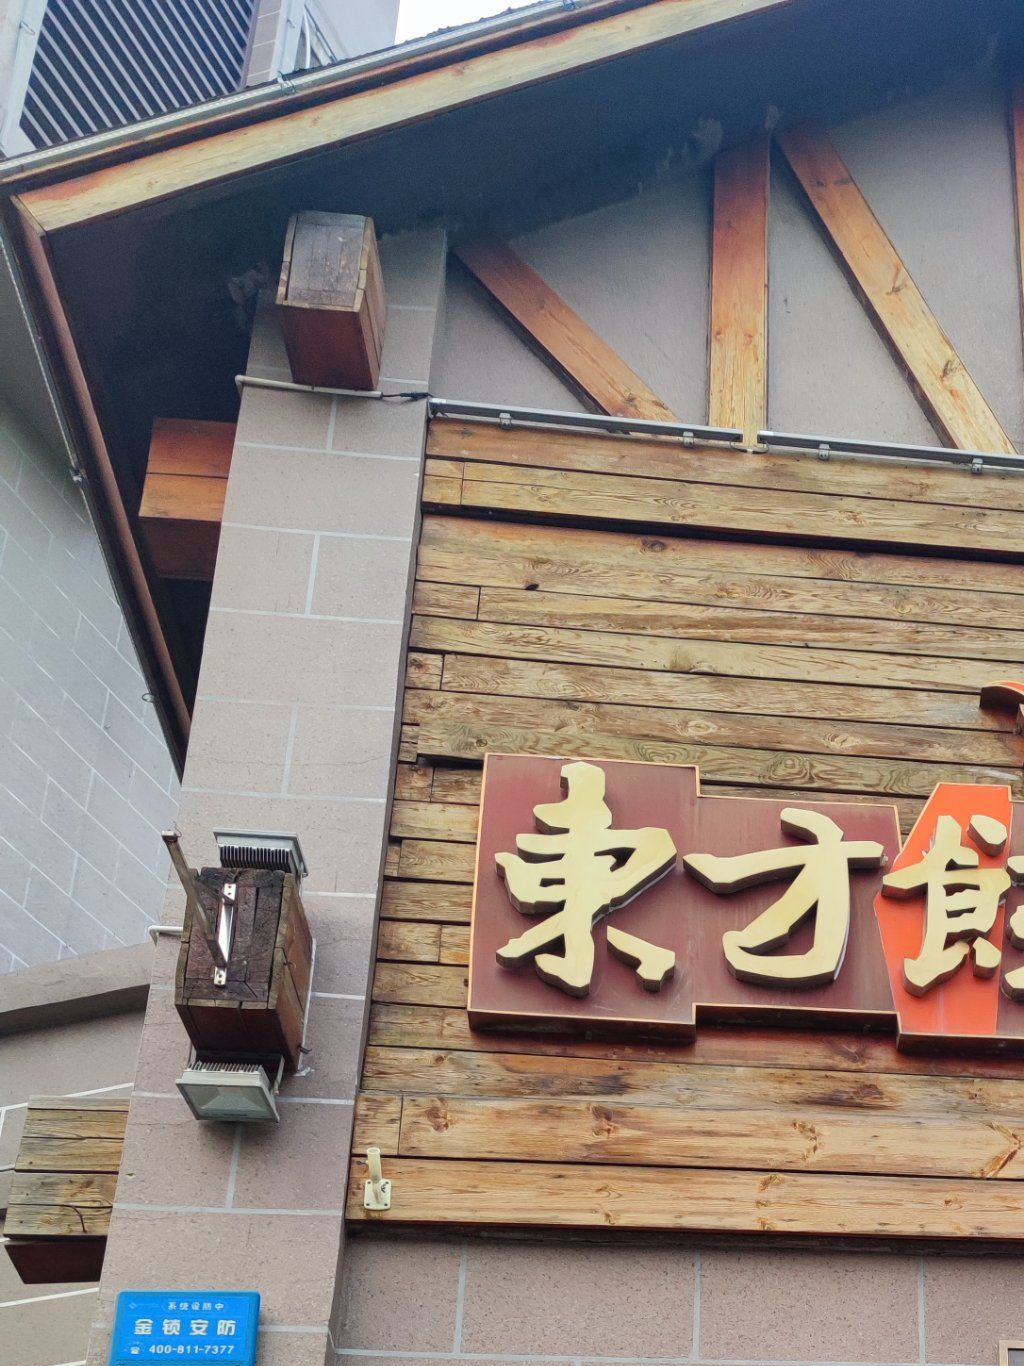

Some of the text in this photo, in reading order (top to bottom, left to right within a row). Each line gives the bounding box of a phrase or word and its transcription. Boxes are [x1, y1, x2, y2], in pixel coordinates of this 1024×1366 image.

[133, 1318, 237, 1336] 金锁安防
[148, 1344, 235, 1355] 400-811-7377
